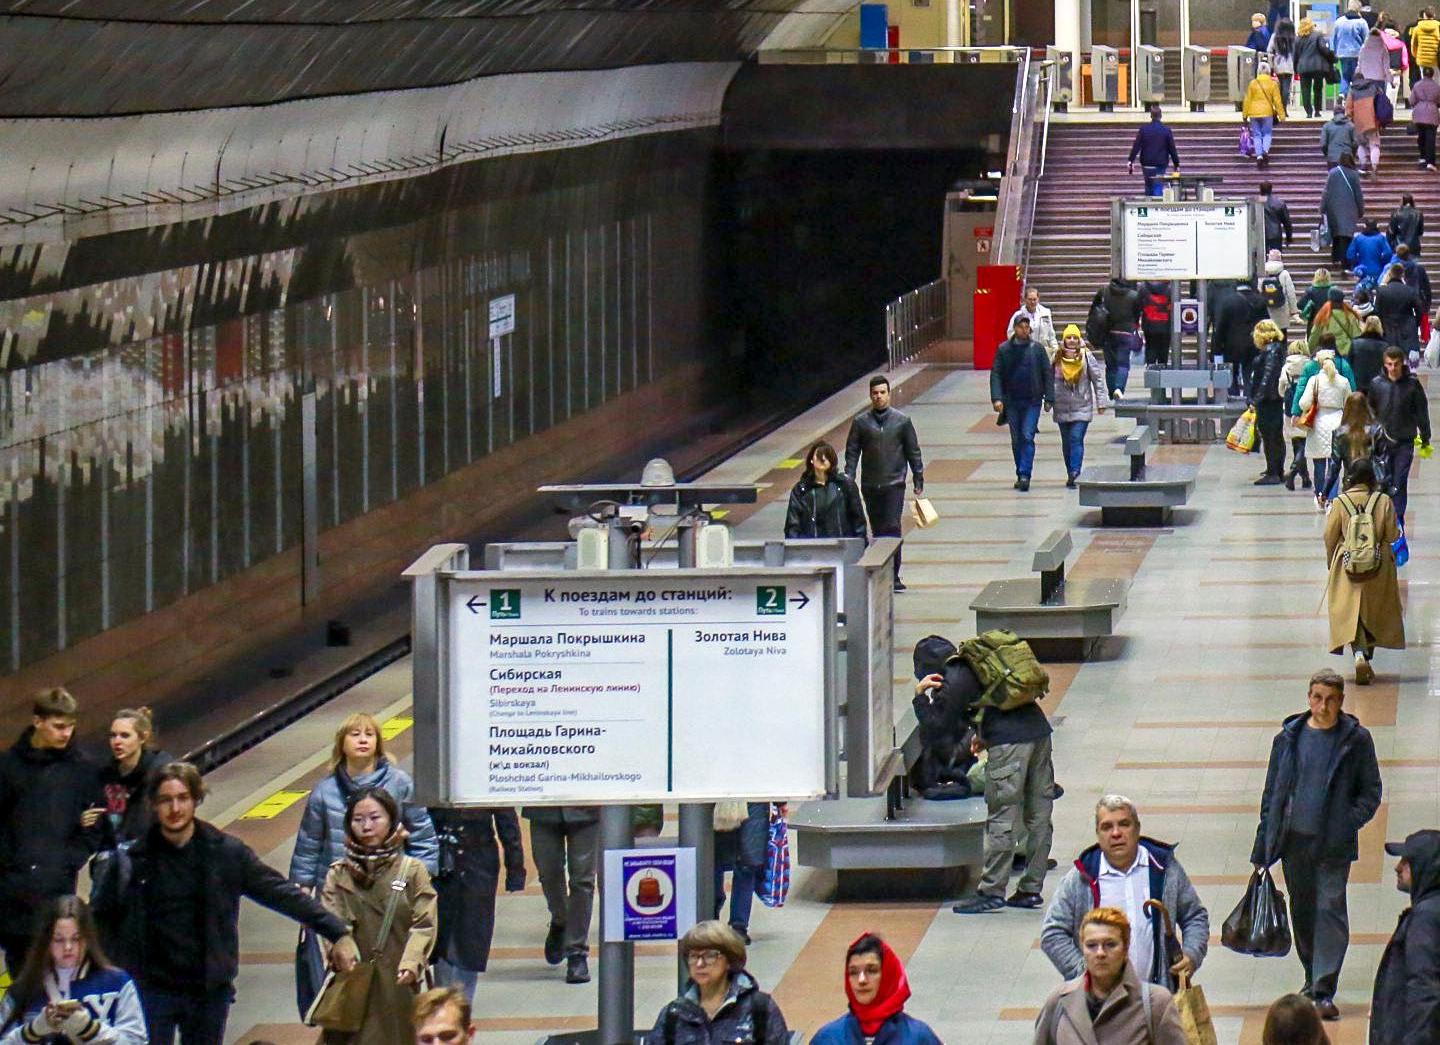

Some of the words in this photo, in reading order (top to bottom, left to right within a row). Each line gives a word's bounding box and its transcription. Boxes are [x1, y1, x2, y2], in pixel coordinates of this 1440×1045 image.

[544, 589, 555, 602] К
[561, 591, 631, 603] поездам
[635, 590, 656, 602] до
[661, 587, 732, 601] станций:
[765, 588, 778, 607] 2
[499, 592, 512, 611] 1
[579, 608, 589, 616] To
[592, 607, 617, 616] trains
[621, 607, 656, 615] towards
[659, 607, 699, 615] stations:
[490, 633, 553, 647] Маршала
[557, 632, 646, 647] Покрышкина
[695, 630, 749, 643] Золотая
[753, 630, 787, 641] Нива
[490, 649, 532, 659] Marshala
[535, 649, 591, 660] Pokryshkina
[724, 646, 763, 657] Zolotaya
[766, 646, 787, 655] Niva
[490, 668, 562, 682] Сибирская
[490, 685, 535, 696] (Переход
[537, 686, 549, 694] на
[551, 685, 603, 696] Ленинскую
[606, 684, 641, 694] линию)
[490, 699, 536, 709] Sibirskaya
[490, 726, 552, 740] Площадь
[555, 725, 607, 739] Гарина-
[489, 743, 596, 755] Михайловского
[513, 760, 550, 770] вокзал)
[489, 773, 535, 783] Ploshchad
